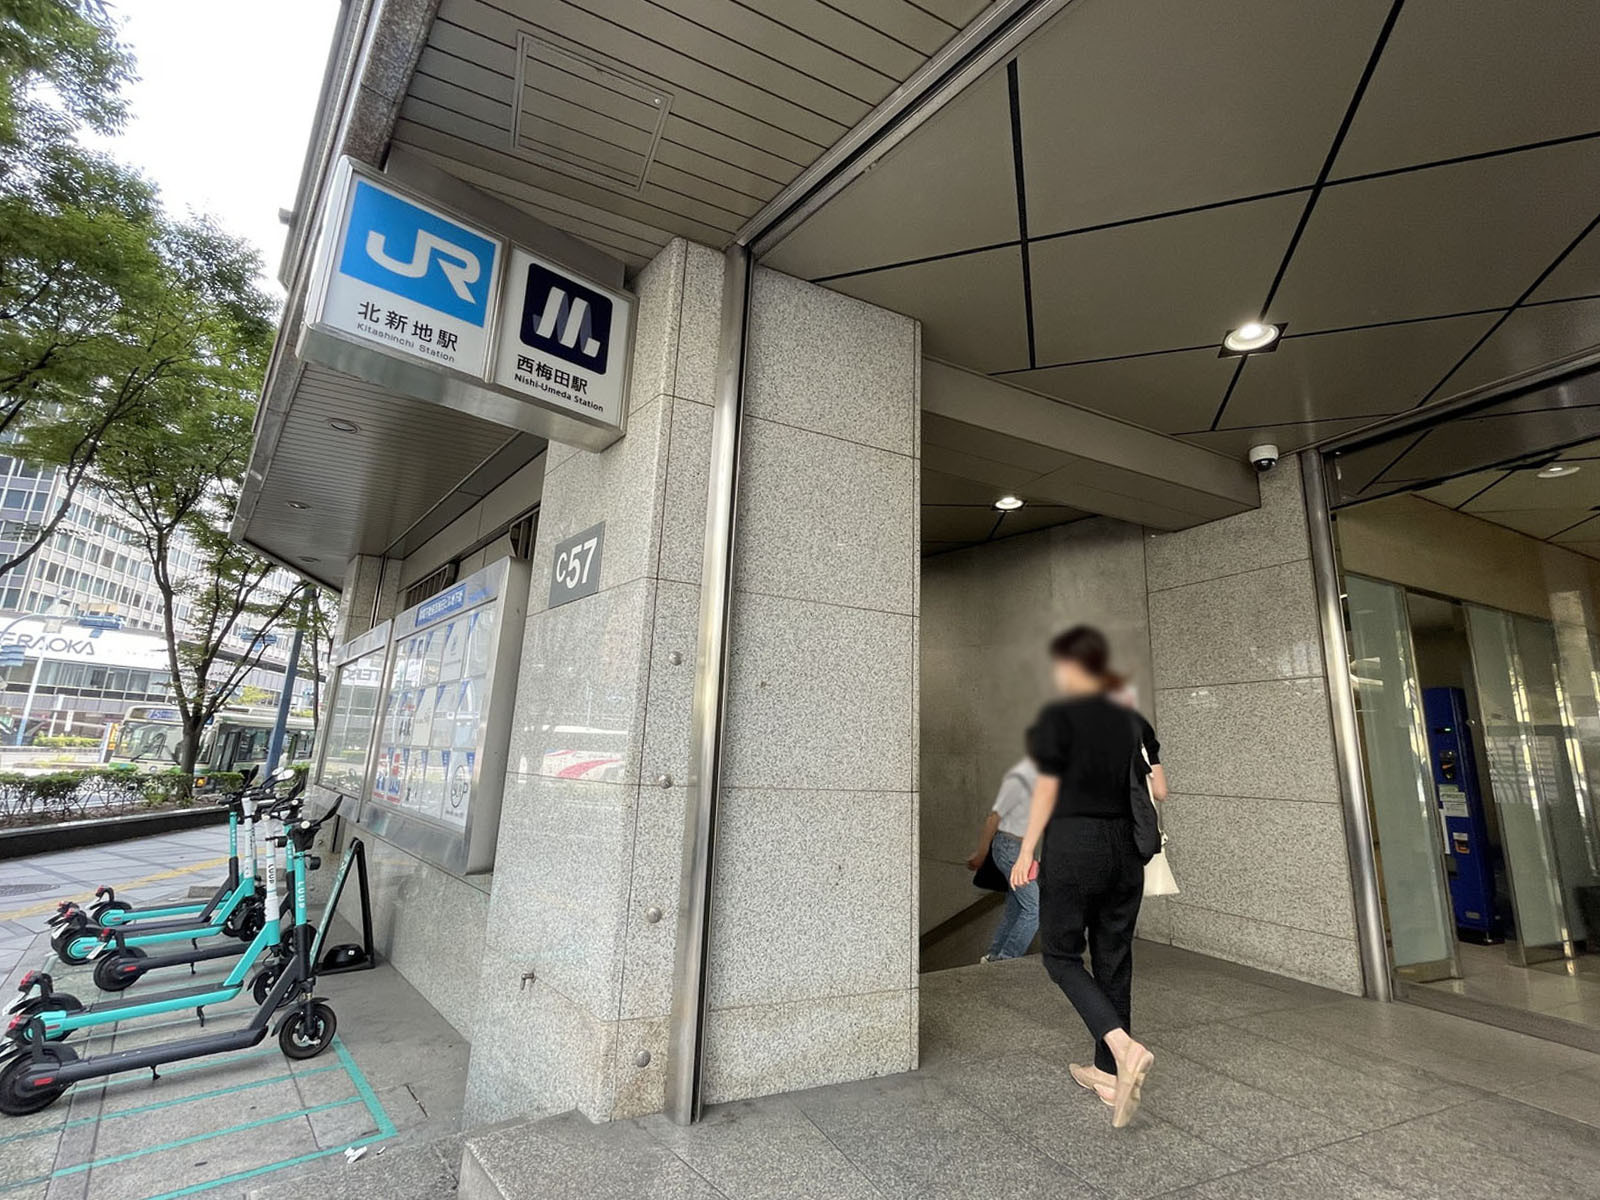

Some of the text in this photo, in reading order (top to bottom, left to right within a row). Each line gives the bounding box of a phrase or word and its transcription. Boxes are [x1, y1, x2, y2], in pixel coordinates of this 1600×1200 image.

[366, 229, 480, 304] JR
[357, 322, 455, 363] Kitashinchi Station
[358, 301, 458, 352] 北新地駅
[514, 373, 604, 412] Nishi-Umeda Station
[517, 354, 588, 395] 西梅田駅
[556, 537, 597, 588] C57
[296, 881, 305, 909] LUUP
